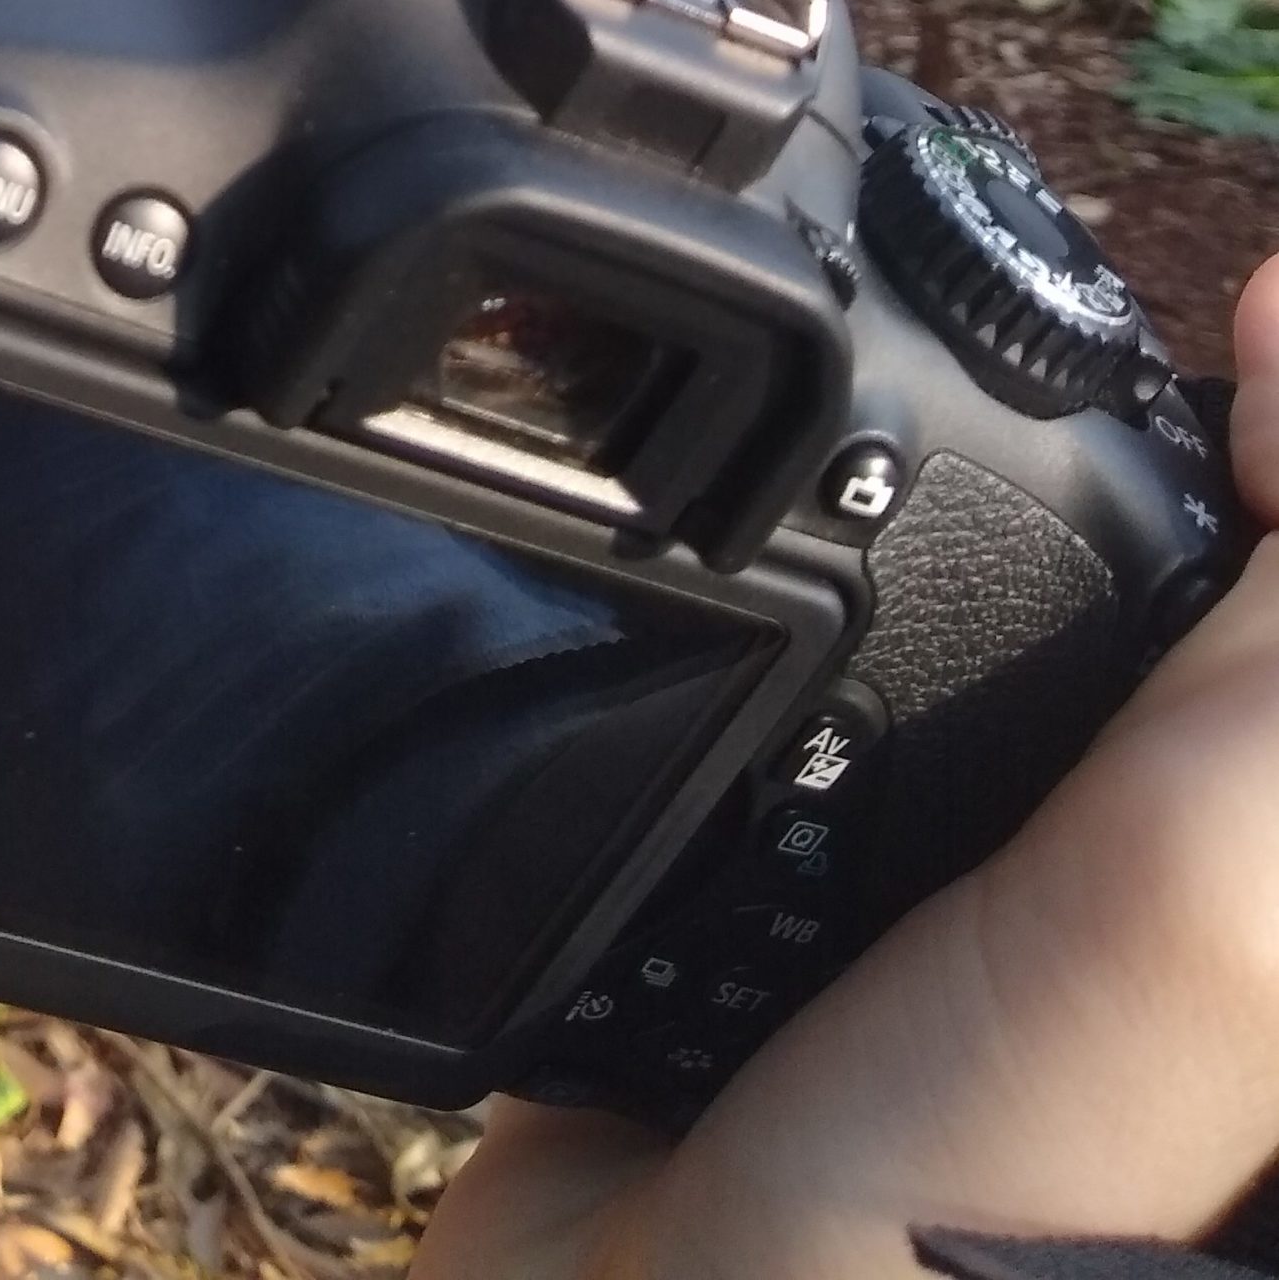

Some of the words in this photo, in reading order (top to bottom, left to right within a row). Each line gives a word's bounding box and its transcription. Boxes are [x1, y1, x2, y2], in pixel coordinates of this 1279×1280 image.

[1155, 415, 1208, 459] OFF
[803, 727, 850, 756] Av
[769, 911, 820, 944] WB
[711, 981, 774, 1012] SET
